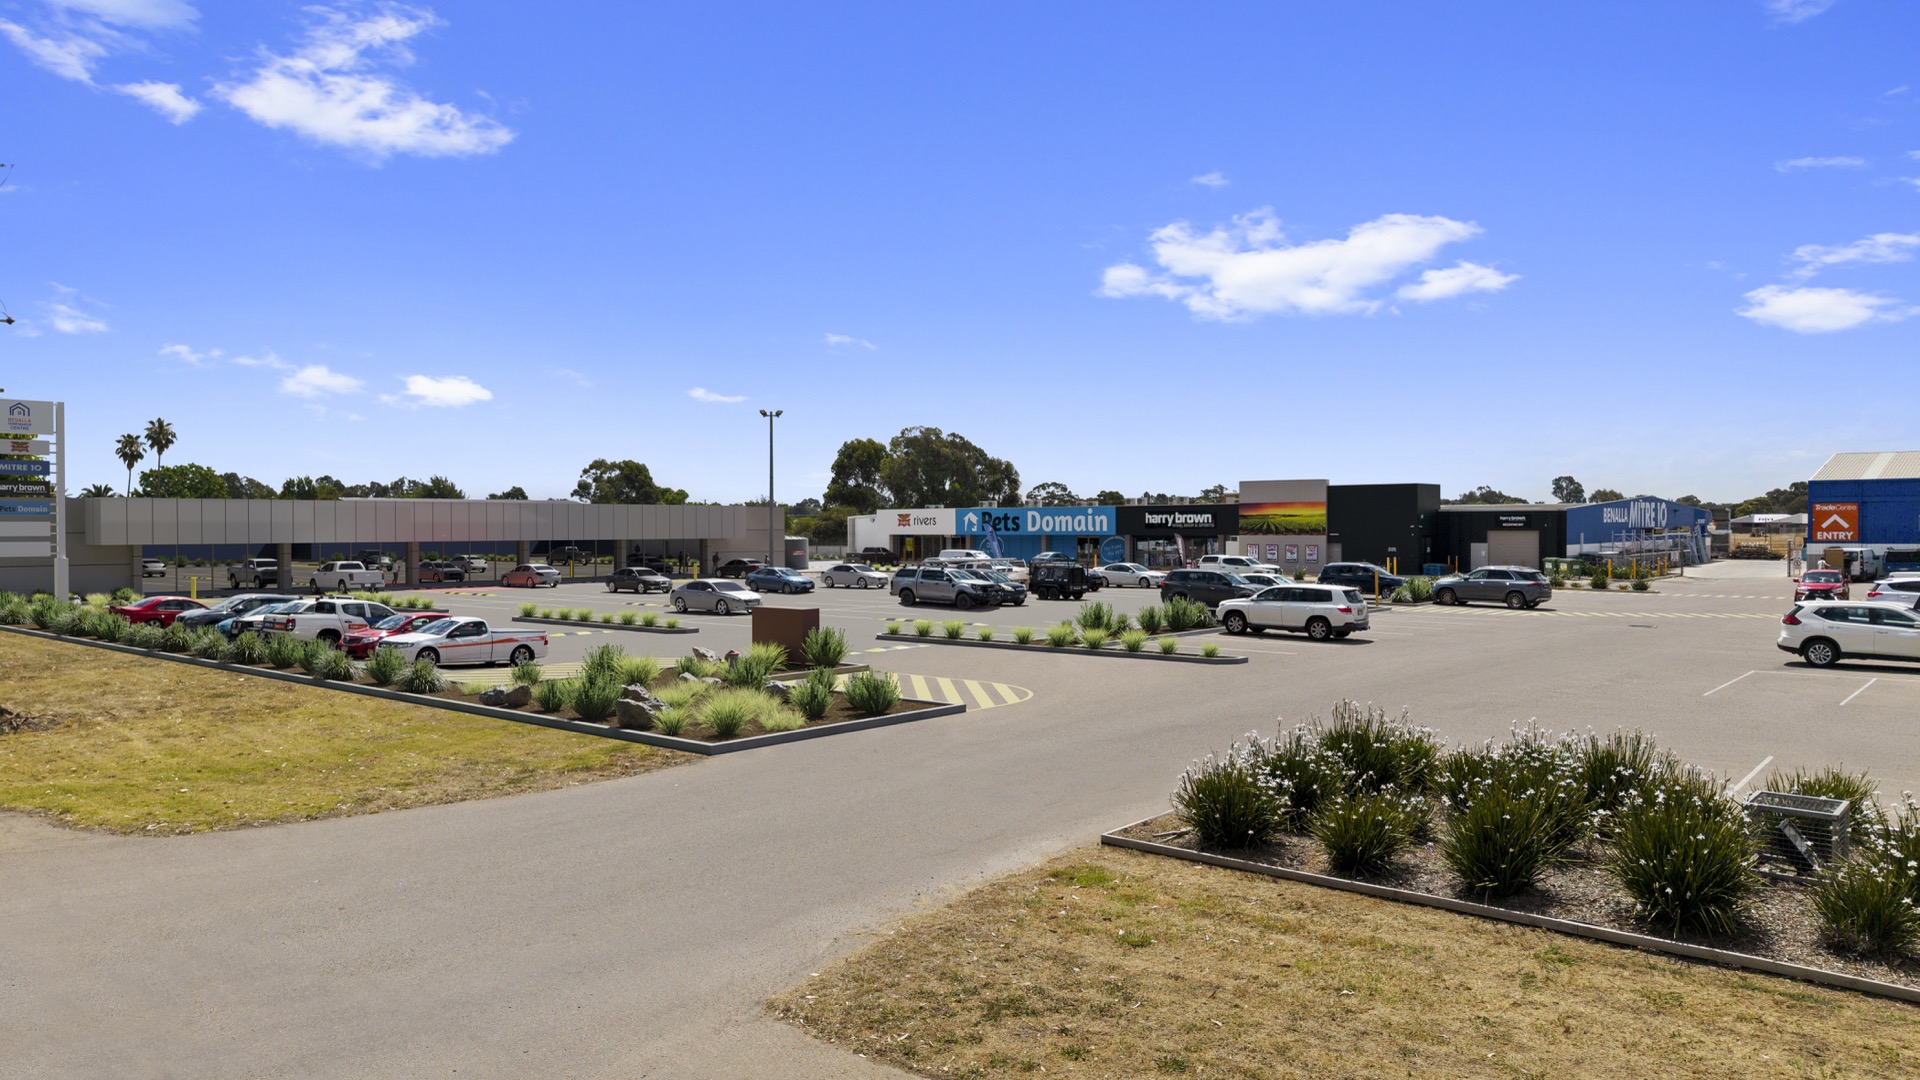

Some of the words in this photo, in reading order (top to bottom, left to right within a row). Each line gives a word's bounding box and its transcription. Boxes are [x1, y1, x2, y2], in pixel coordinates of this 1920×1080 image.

[0, 463, 28, 471] MITRE
[0, 484, 18, 493] arry
[17, 505, 48, 513] Domain
[1603, 507, 1628, 523] BENALLA
[1628, 500, 1655, 528] MITRE
[1657, 501, 1668, 528] 10
[913, 515, 937, 526] rivers
[981, 511, 1020, 532] Pets
[1027, 508, 1108, 532] Domain
[1145, 512, 1174, 527] harry
[1817, 531, 1854, 540] ENTRY
